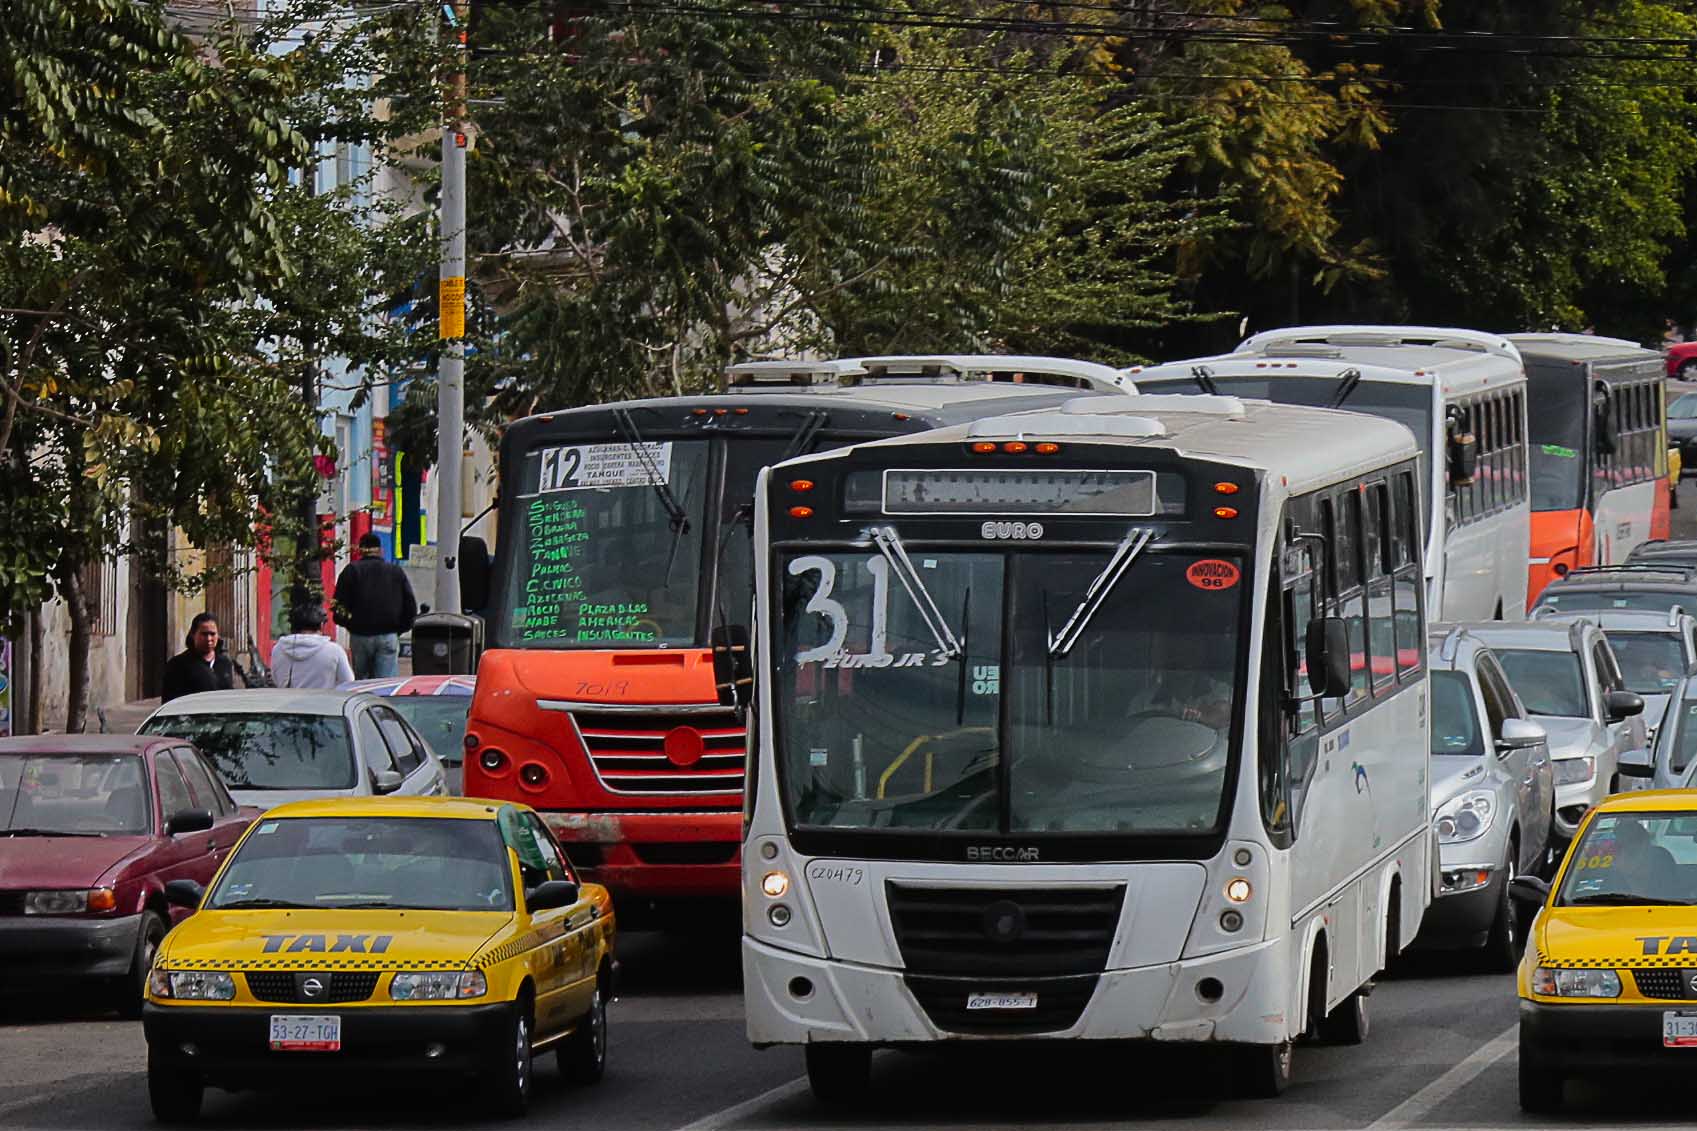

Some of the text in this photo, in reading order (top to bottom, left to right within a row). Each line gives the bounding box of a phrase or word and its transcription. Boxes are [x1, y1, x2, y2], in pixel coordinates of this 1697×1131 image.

[545, 447, 581, 489] 12
[586, 469, 625, 479] TANQUE
[981, 521, 1045, 540] EURO
[1201, 577, 1223, 588] 96
[788, 555, 890, 666] 31
[967, 847, 1040, 860] BECCAR
[261, 934, 393, 954] TAXI
[272, 1024, 338, 1040] 53-27-TGH
